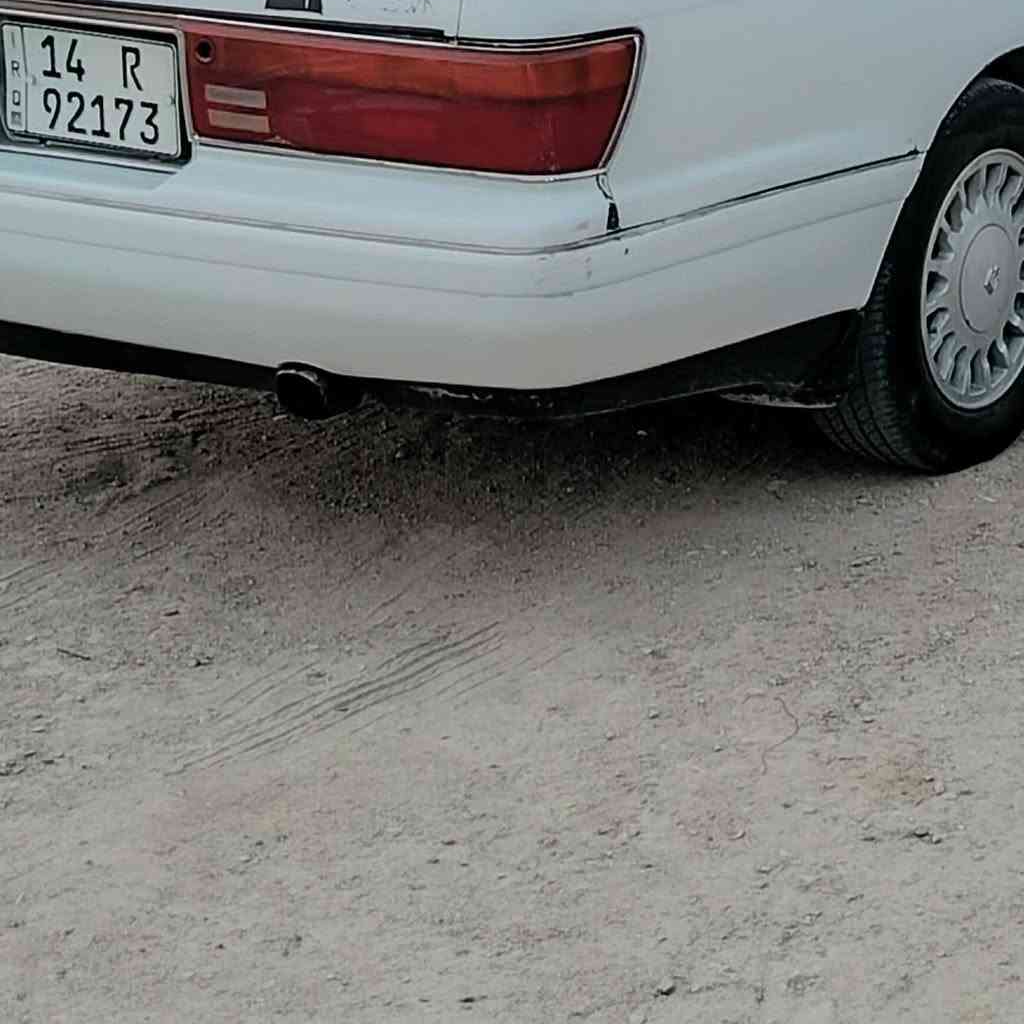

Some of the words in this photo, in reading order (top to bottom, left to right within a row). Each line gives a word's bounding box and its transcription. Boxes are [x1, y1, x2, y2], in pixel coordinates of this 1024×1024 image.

[41, 35, 85, 82] 14
[121, 45, 143, 91] R
[43, 88, 160, 145] 92173
